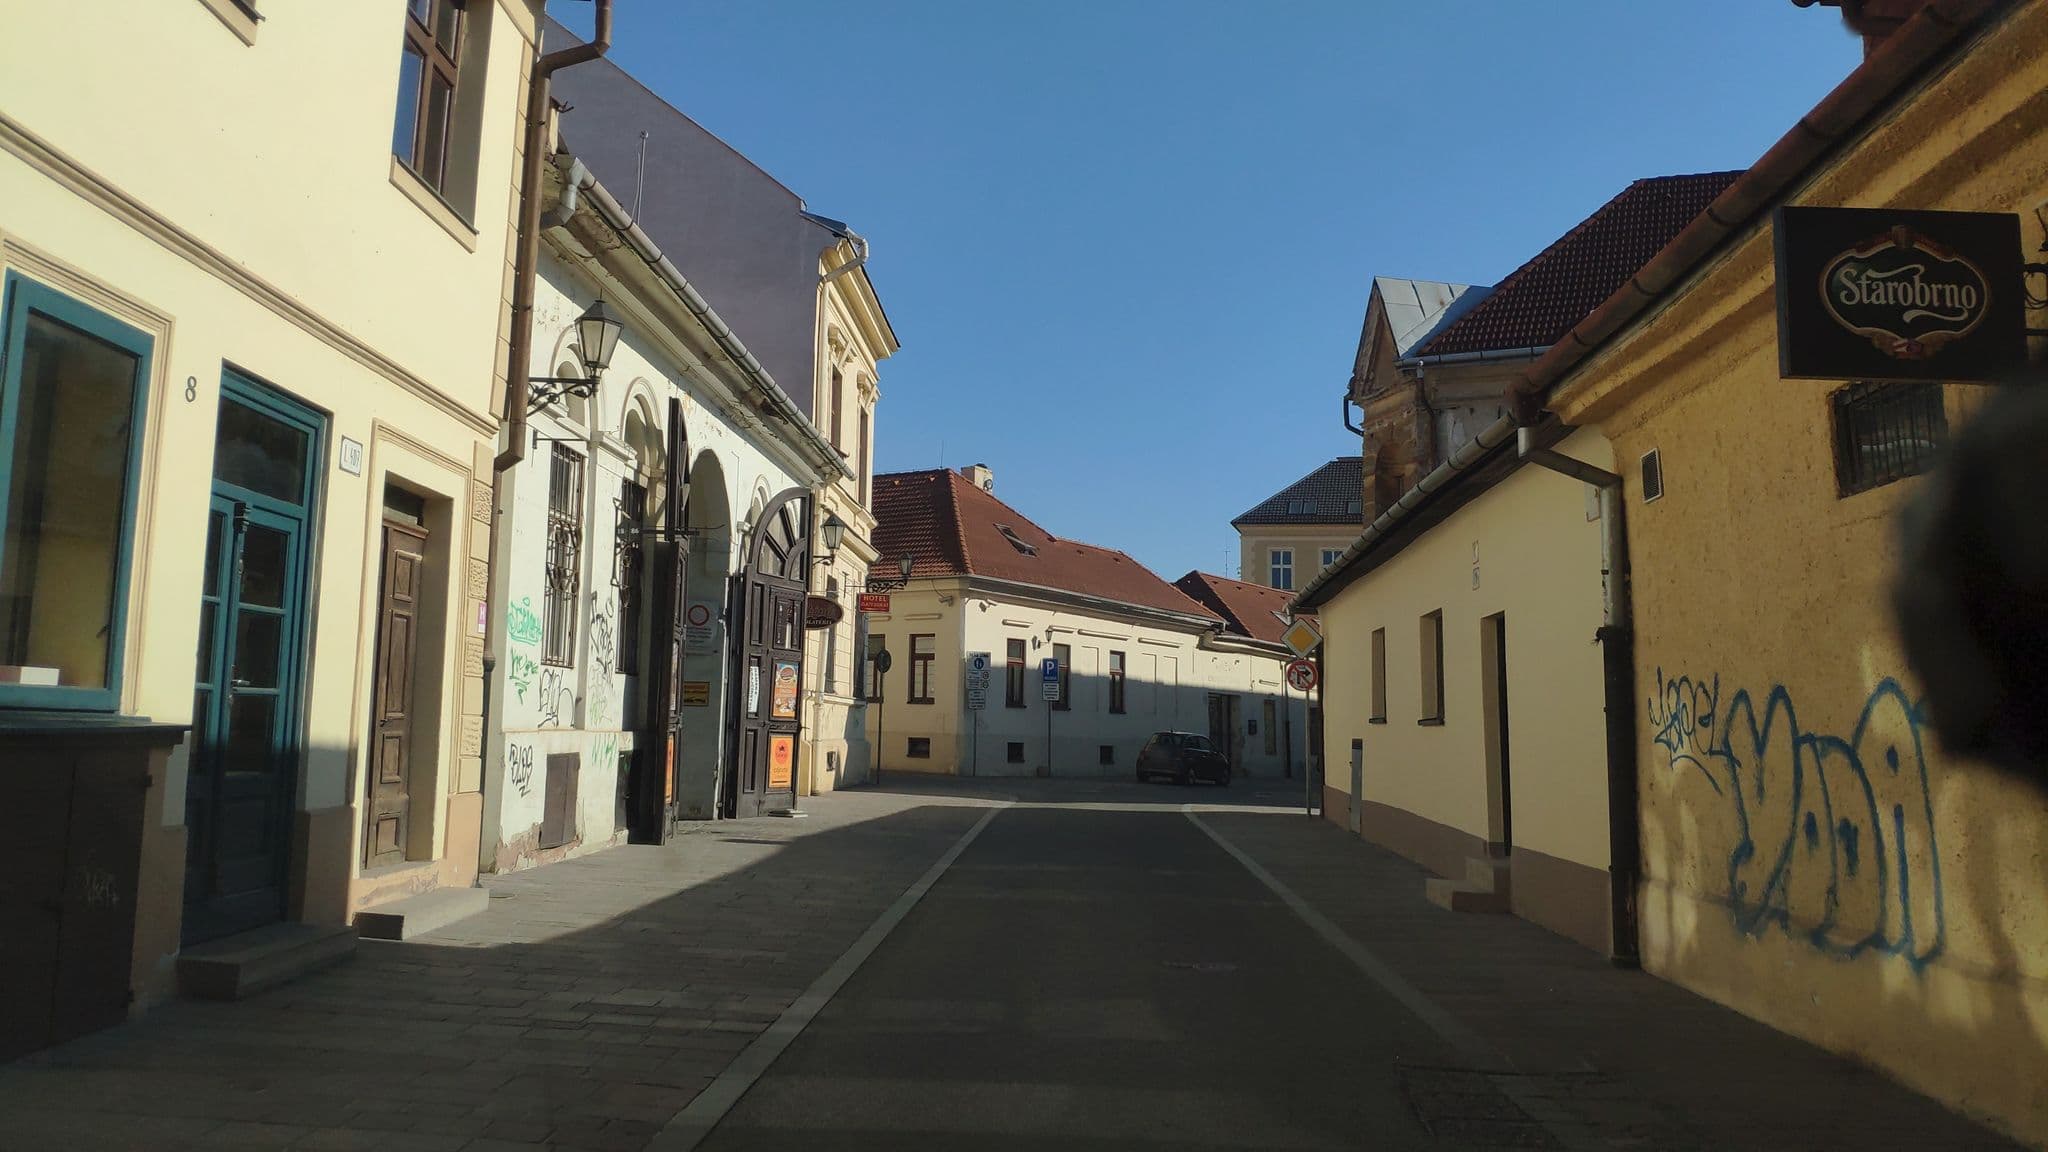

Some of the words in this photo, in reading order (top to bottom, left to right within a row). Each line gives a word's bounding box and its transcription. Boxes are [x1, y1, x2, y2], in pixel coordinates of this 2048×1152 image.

[1839, 264, 1977, 323] Starobrno
[185, 375, 197, 403] 8
[863, 594, 887, 602] HOTEL
[1046, 660, 1055, 675] P
